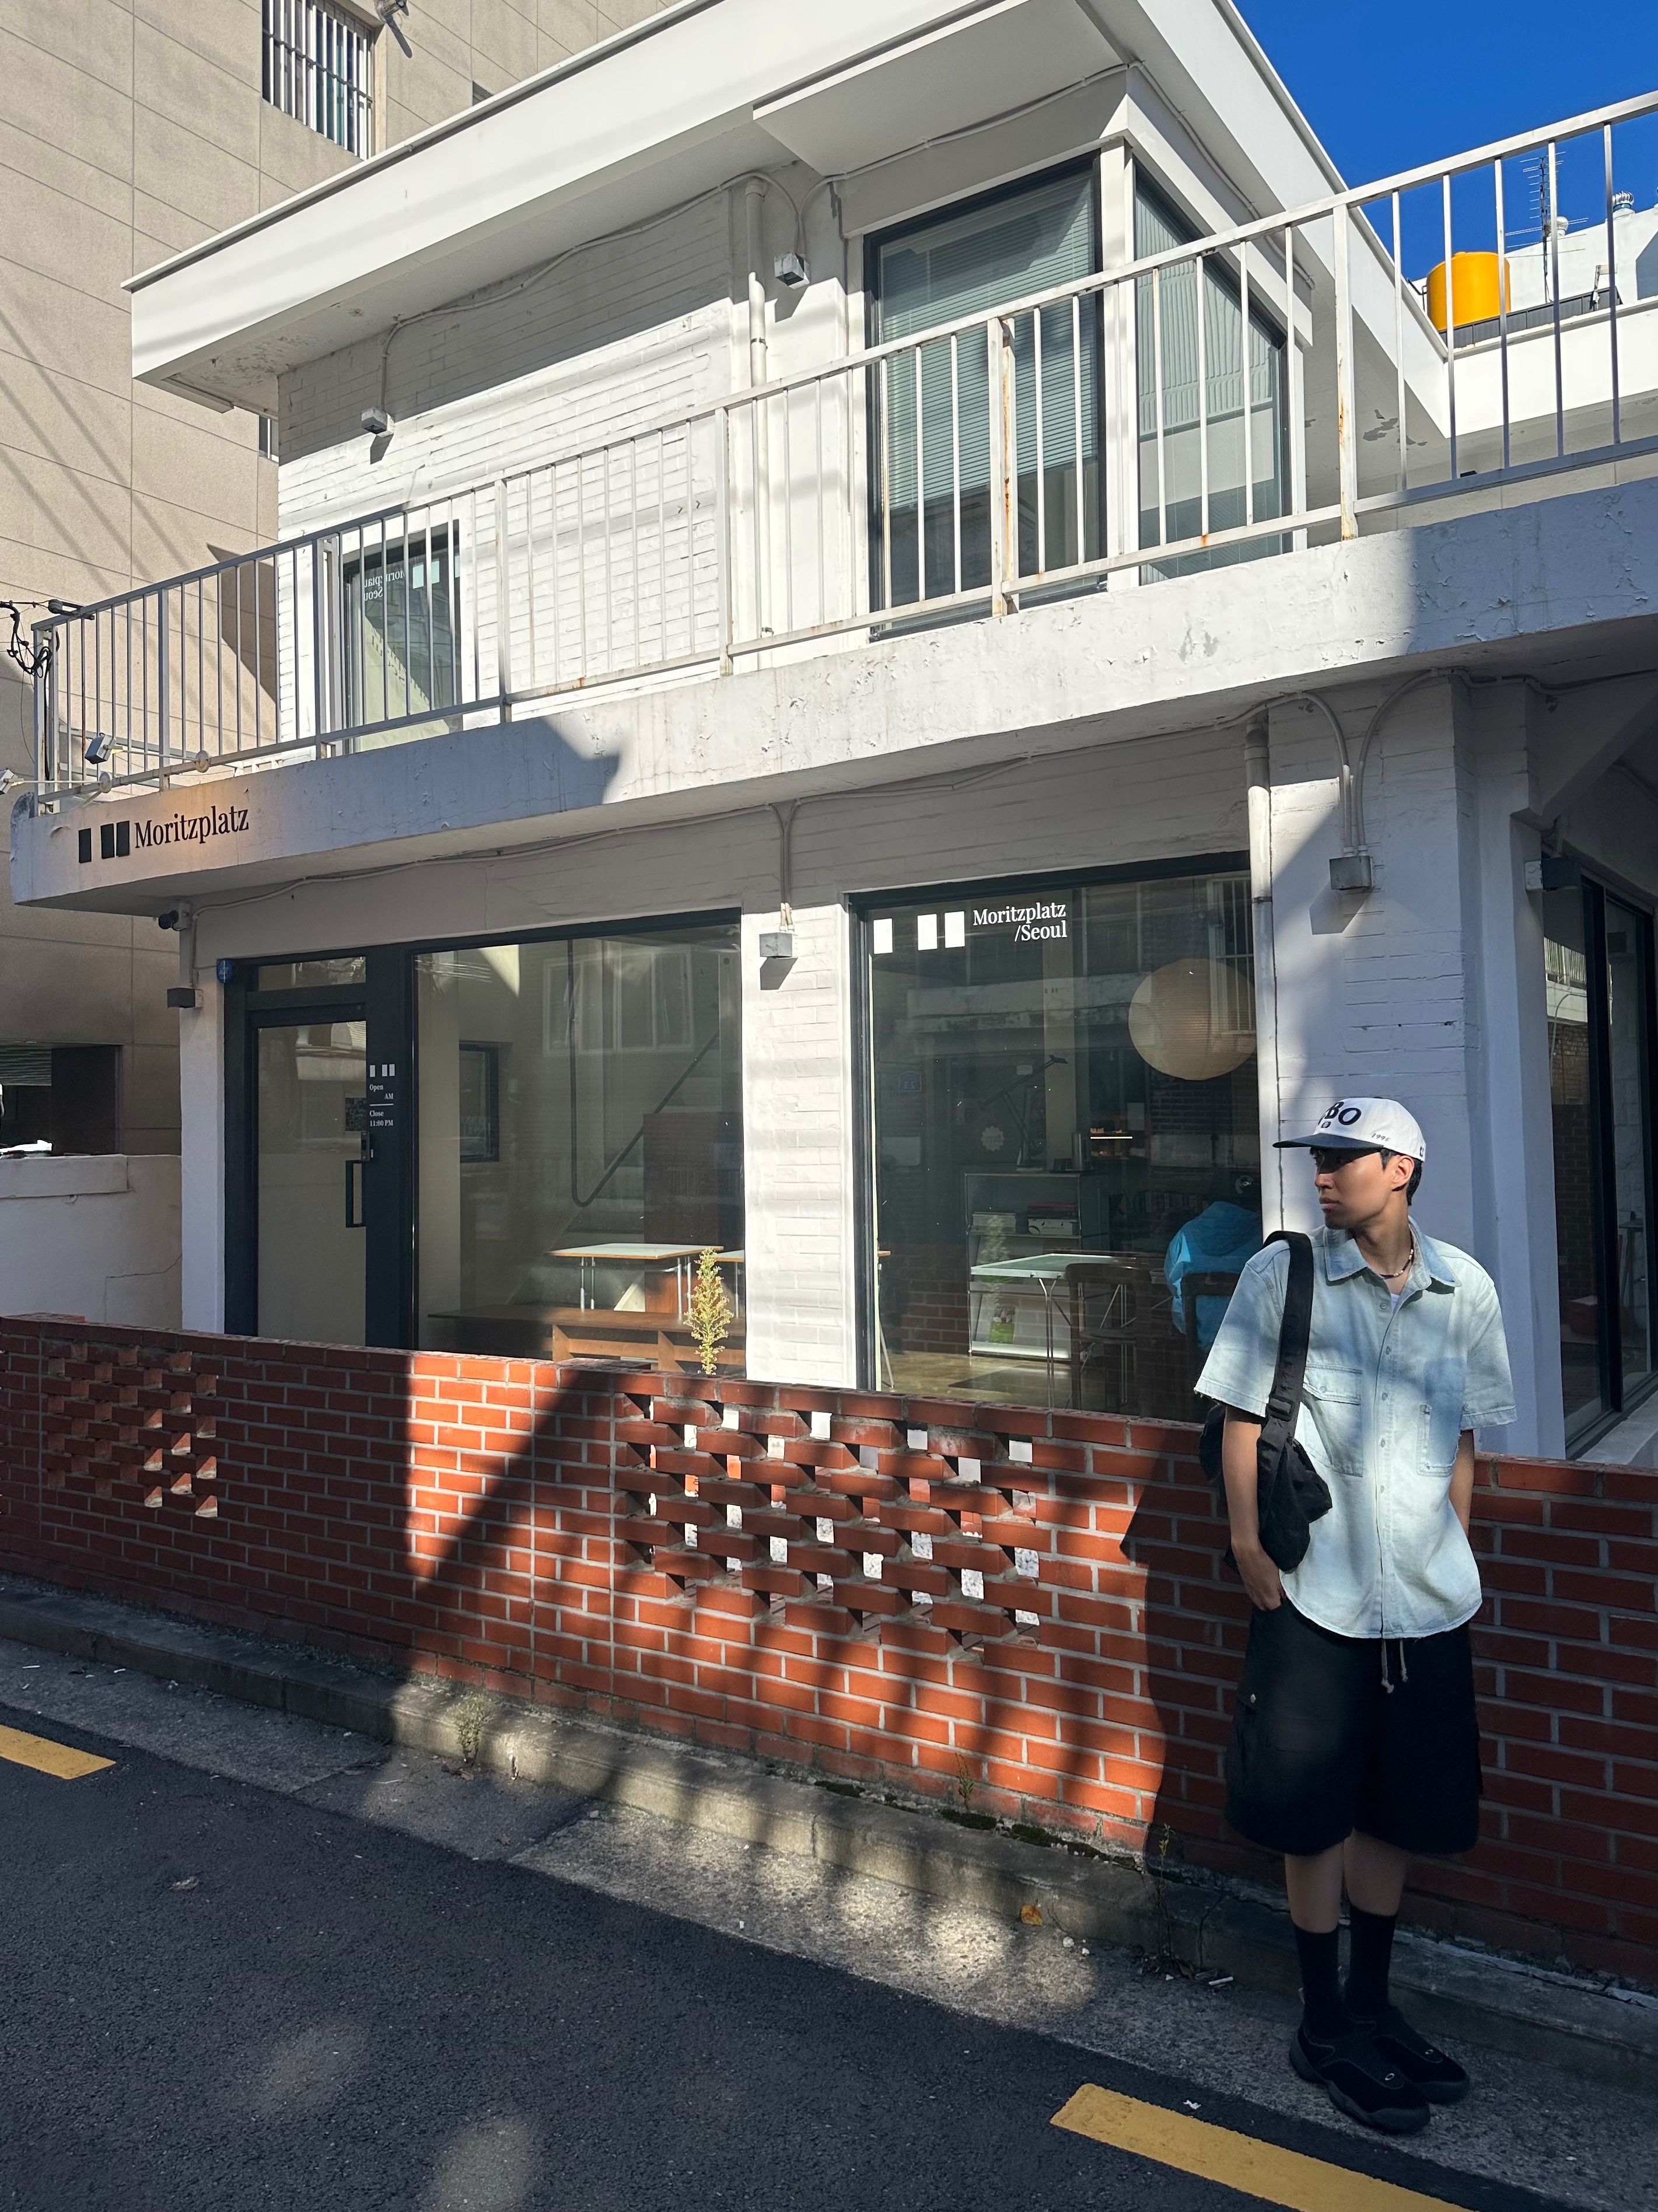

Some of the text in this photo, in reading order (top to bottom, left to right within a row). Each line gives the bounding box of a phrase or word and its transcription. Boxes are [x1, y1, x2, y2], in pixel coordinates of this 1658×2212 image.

[134, 805, 249, 848] Moritzplatz
[973, 902, 1066, 926] Moritzplatz
[1014, 920, 1068, 942] /Seoul
[369, 1084, 384, 1092] Open
[1318, 1101, 1362, 1126] BO
